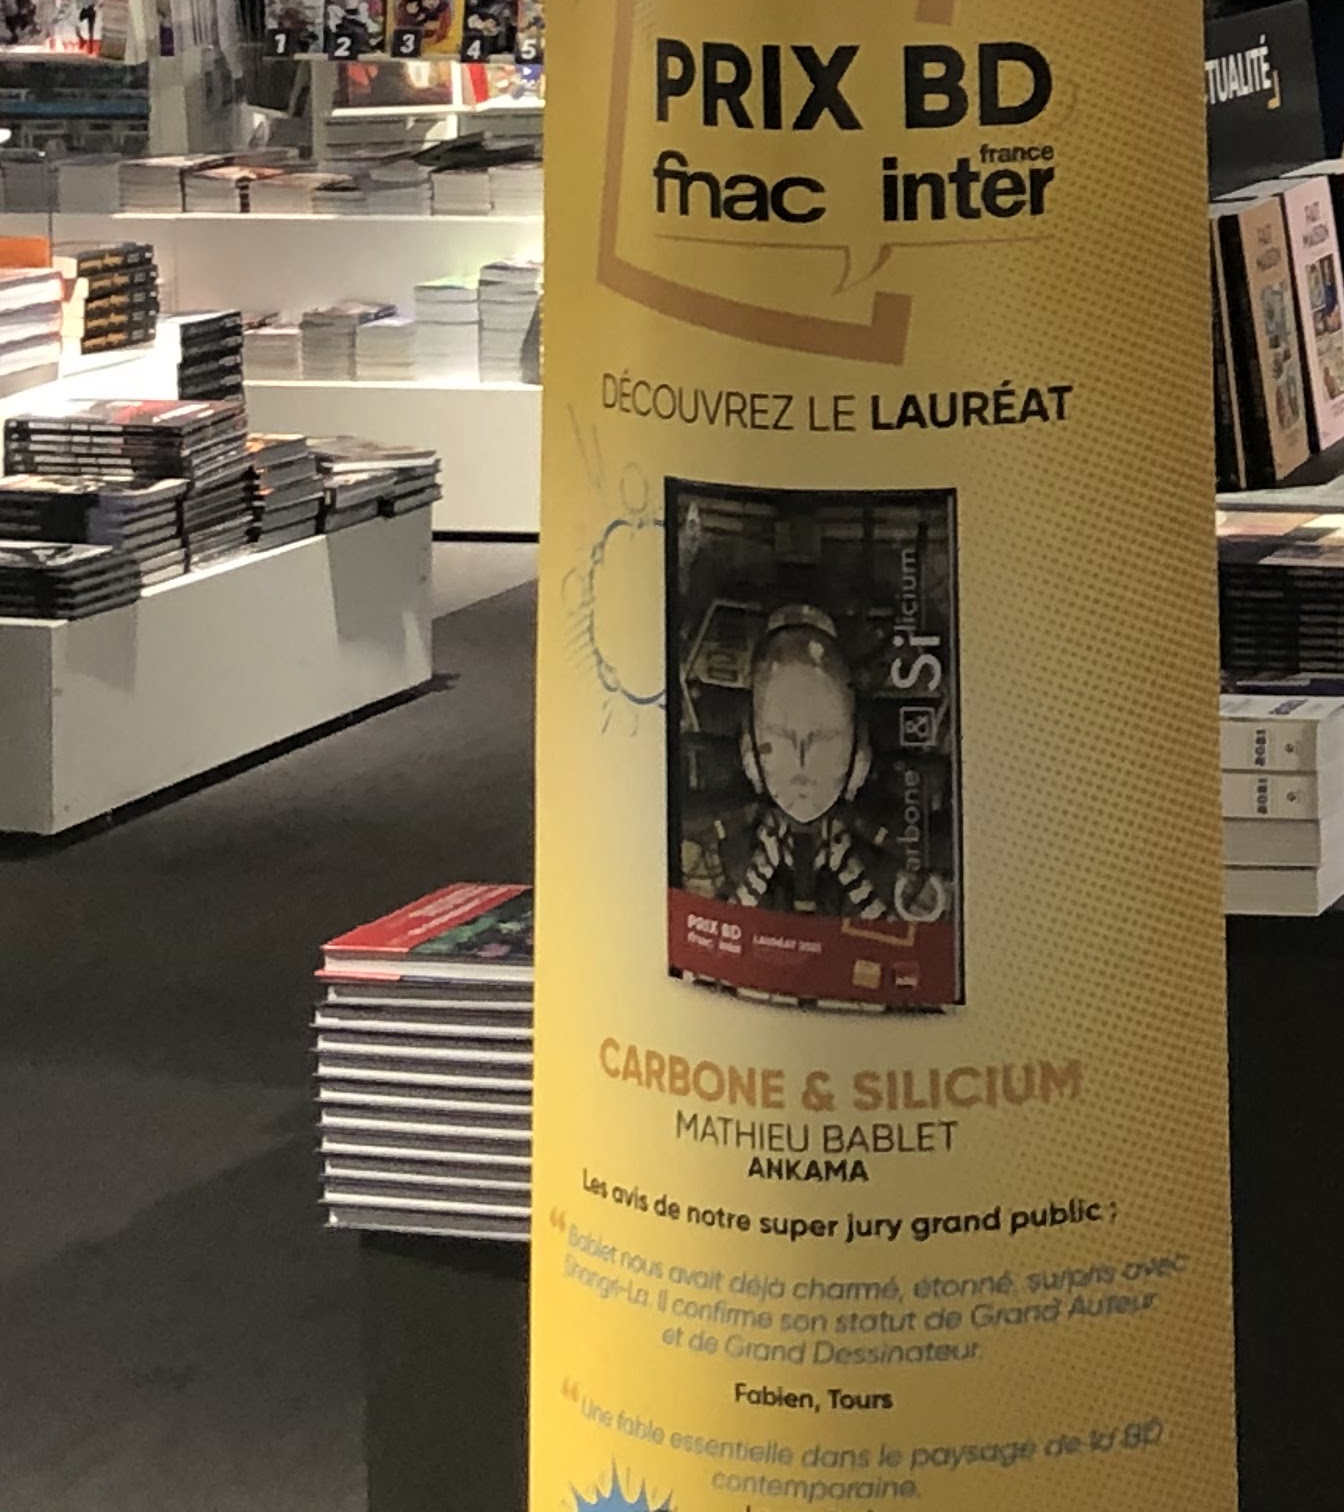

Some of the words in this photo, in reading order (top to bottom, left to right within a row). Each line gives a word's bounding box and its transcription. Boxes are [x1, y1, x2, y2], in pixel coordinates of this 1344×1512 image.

[275, 34, 289, 55] 1
[334, 37, 352, 58] 2
[400, 33, 416, 54] 3
[466, 40, 482, 61] 4
[520, 38, 536, 60] 5
[656, 37, 862, 131] PRIX
[903, 42, 1055, 128] BD
[978, 143, 1055, 164] france
[652, 149, 826, 224] fnac
[881, 156, 1055, 222] inter
[602, 370, 794, 432] DÉCOUVREZ
[808, 395, 857, 432] LE
[871, 380, 1073, 431] LAURÉAT
[891, 545, 943, 692] Silicium
[894, 768, 947, 924] Carbone
[600, 1037, 786, 1111] CARBONE
[800, 1070, 836, 1113] &
[852, 1058, 1086, 1111] SILICIUM
[675, 1109, 811, 1153] MATHIEU
[823, 1119, 959, 1153] BABLET
[747, 1155, 871, 1183] ANKAMA
[582, 1168, 609, 1200] Les
[612, 1182, 650, 1213] avis
[654, 1194, 681, 1221] de
[687, 1202, 752, 1233] notre
[760, 1213, 840, 1243] super
[846, 1213, 904, 1243] jury
[911, 1205, 1002, 1242] grand
[1009, 1197, 1103, 1236] public
[620, 1250, 663, 1278] nous
[668, 1264, 725, 1289] avait
[730, 1272, 785, 1302] déjà
[1122, 1251, 1190, 1281] avec
[671, 1295, 773, 1329] confirme
[780, 1311, 828, 1333] son
[834, 1307, 916, 1334] statut
[924, 1308, 962, 1331] de
[971, 1298, 1062, 1329] Grand
[661, 1325, 684, 1347] et
[688, 1330, 719, 1355] de
[724, 1334, 806, 1365] Grand
[734, 1381, 821, 1414] Fabien,
[827, 1388, 894, 1410] Tours
[670, 1430, 793, 1466] essentielle
[802, 1443, 870, 1469] dans
[878, 1443, 903, 1468] le
[911, 1439, 1038, 1471] paysage
[1044, 1433, 1082, 1457] de
